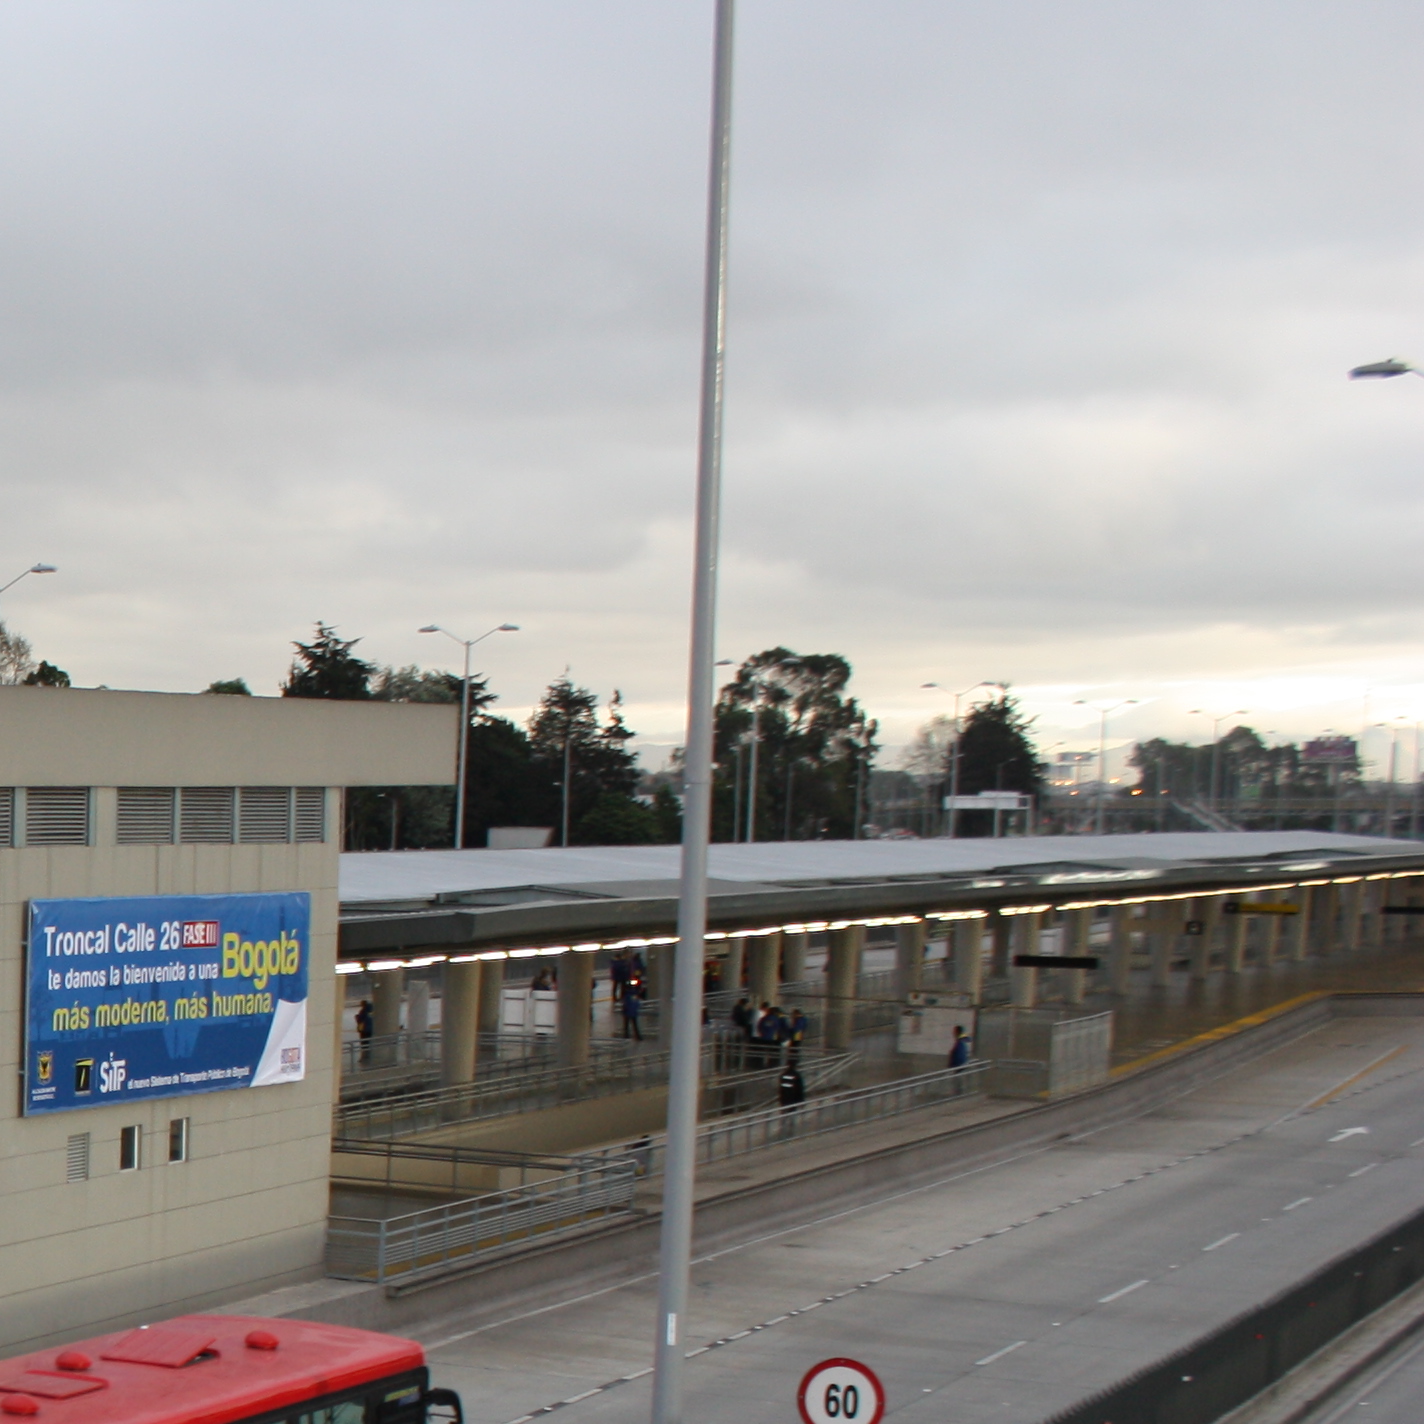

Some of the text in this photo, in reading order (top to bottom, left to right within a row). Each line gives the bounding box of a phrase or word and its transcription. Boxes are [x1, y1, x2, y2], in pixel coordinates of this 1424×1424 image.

[44, 924, 109, 957] Troncal
[114, 922, 155, 953] Calle
[160, 920, 180, 950] 26
[183, 923, 206, 945] FASE
[48, 961, 219, 990] te damos la bienvenida a una
[223, 929, 299, 990] Bogotá
[53, 991, 274, 1031] más moderna, más humana.
[825, 1384, 858, 1419] 60
